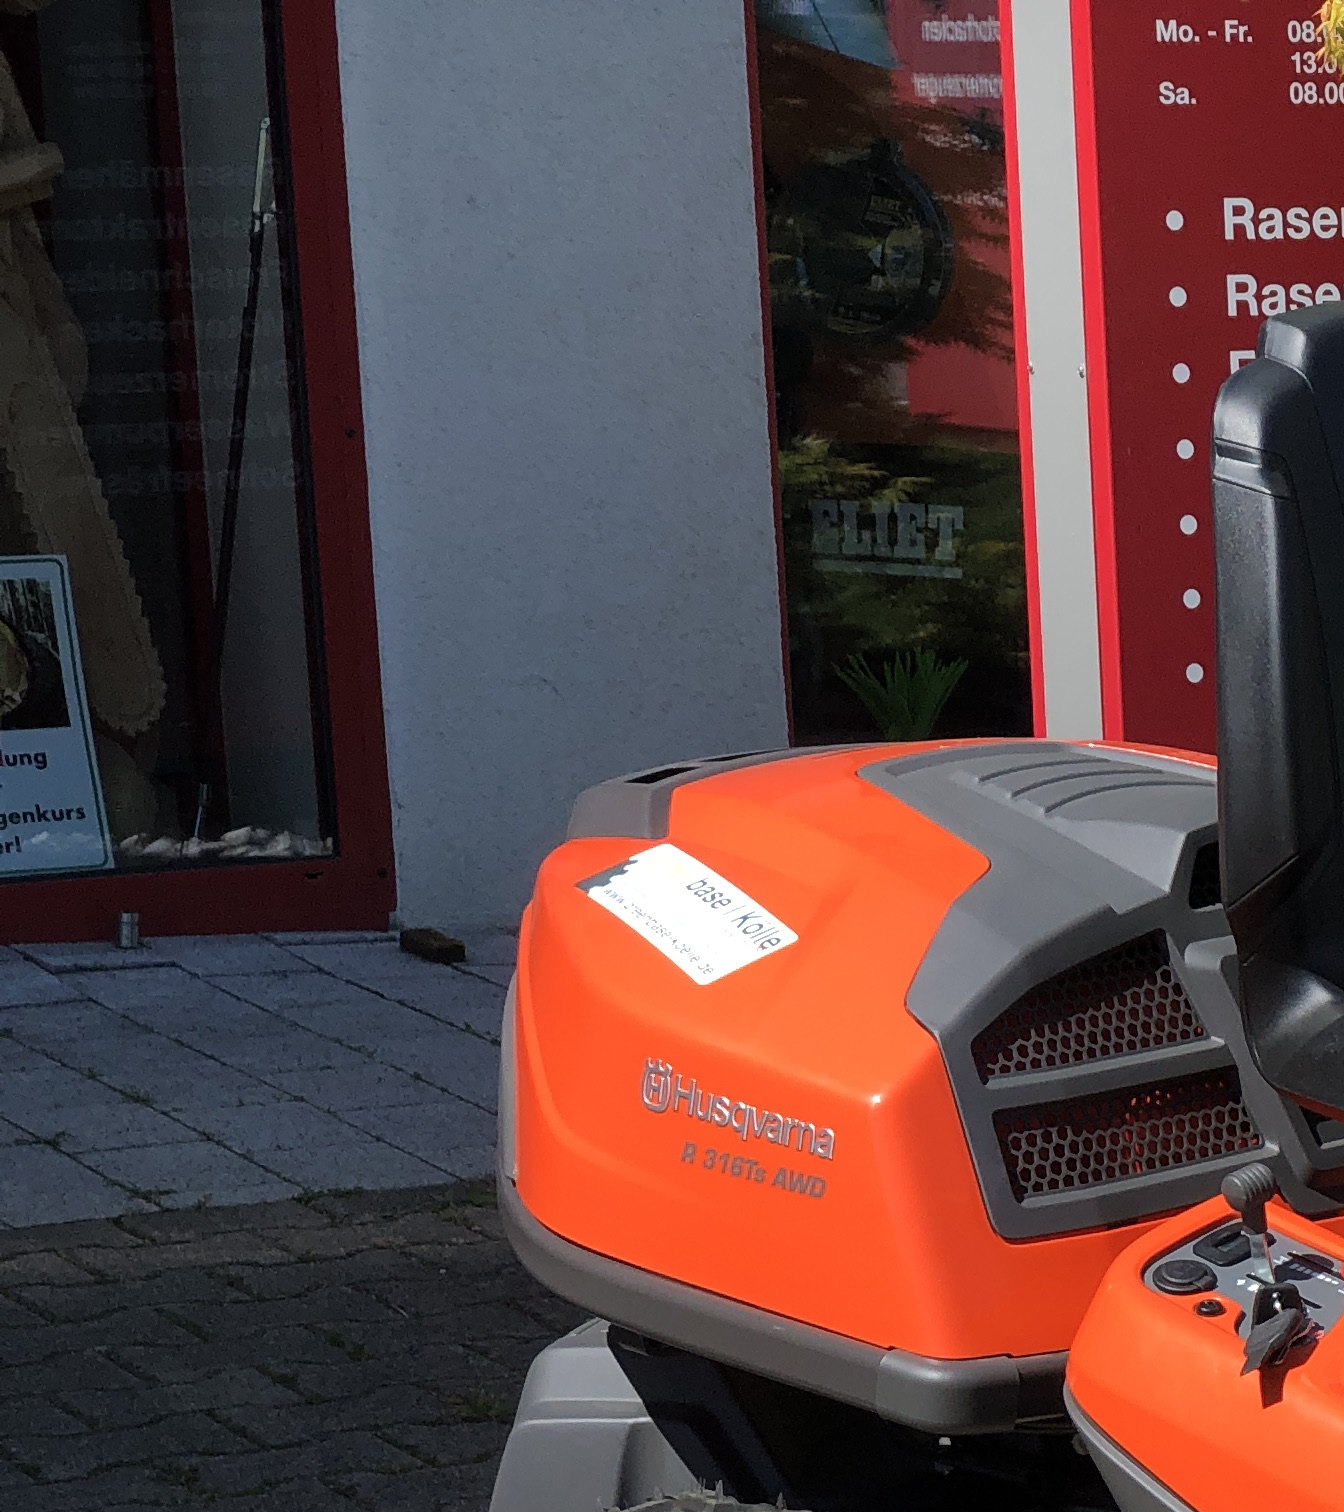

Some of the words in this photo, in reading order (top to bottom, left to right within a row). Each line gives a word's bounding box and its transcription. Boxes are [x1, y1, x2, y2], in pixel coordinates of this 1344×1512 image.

[1155, 19, 1200, 43] Mo.
[1224, 20, 1253, 43] Fr.
[1159, 82, 1197, 105] Sa.
[673, 1073, 836, 1162] Husqvarna
[681, 1141, 697, 1164] R
[771, 1167, 826, 1200] AWD
